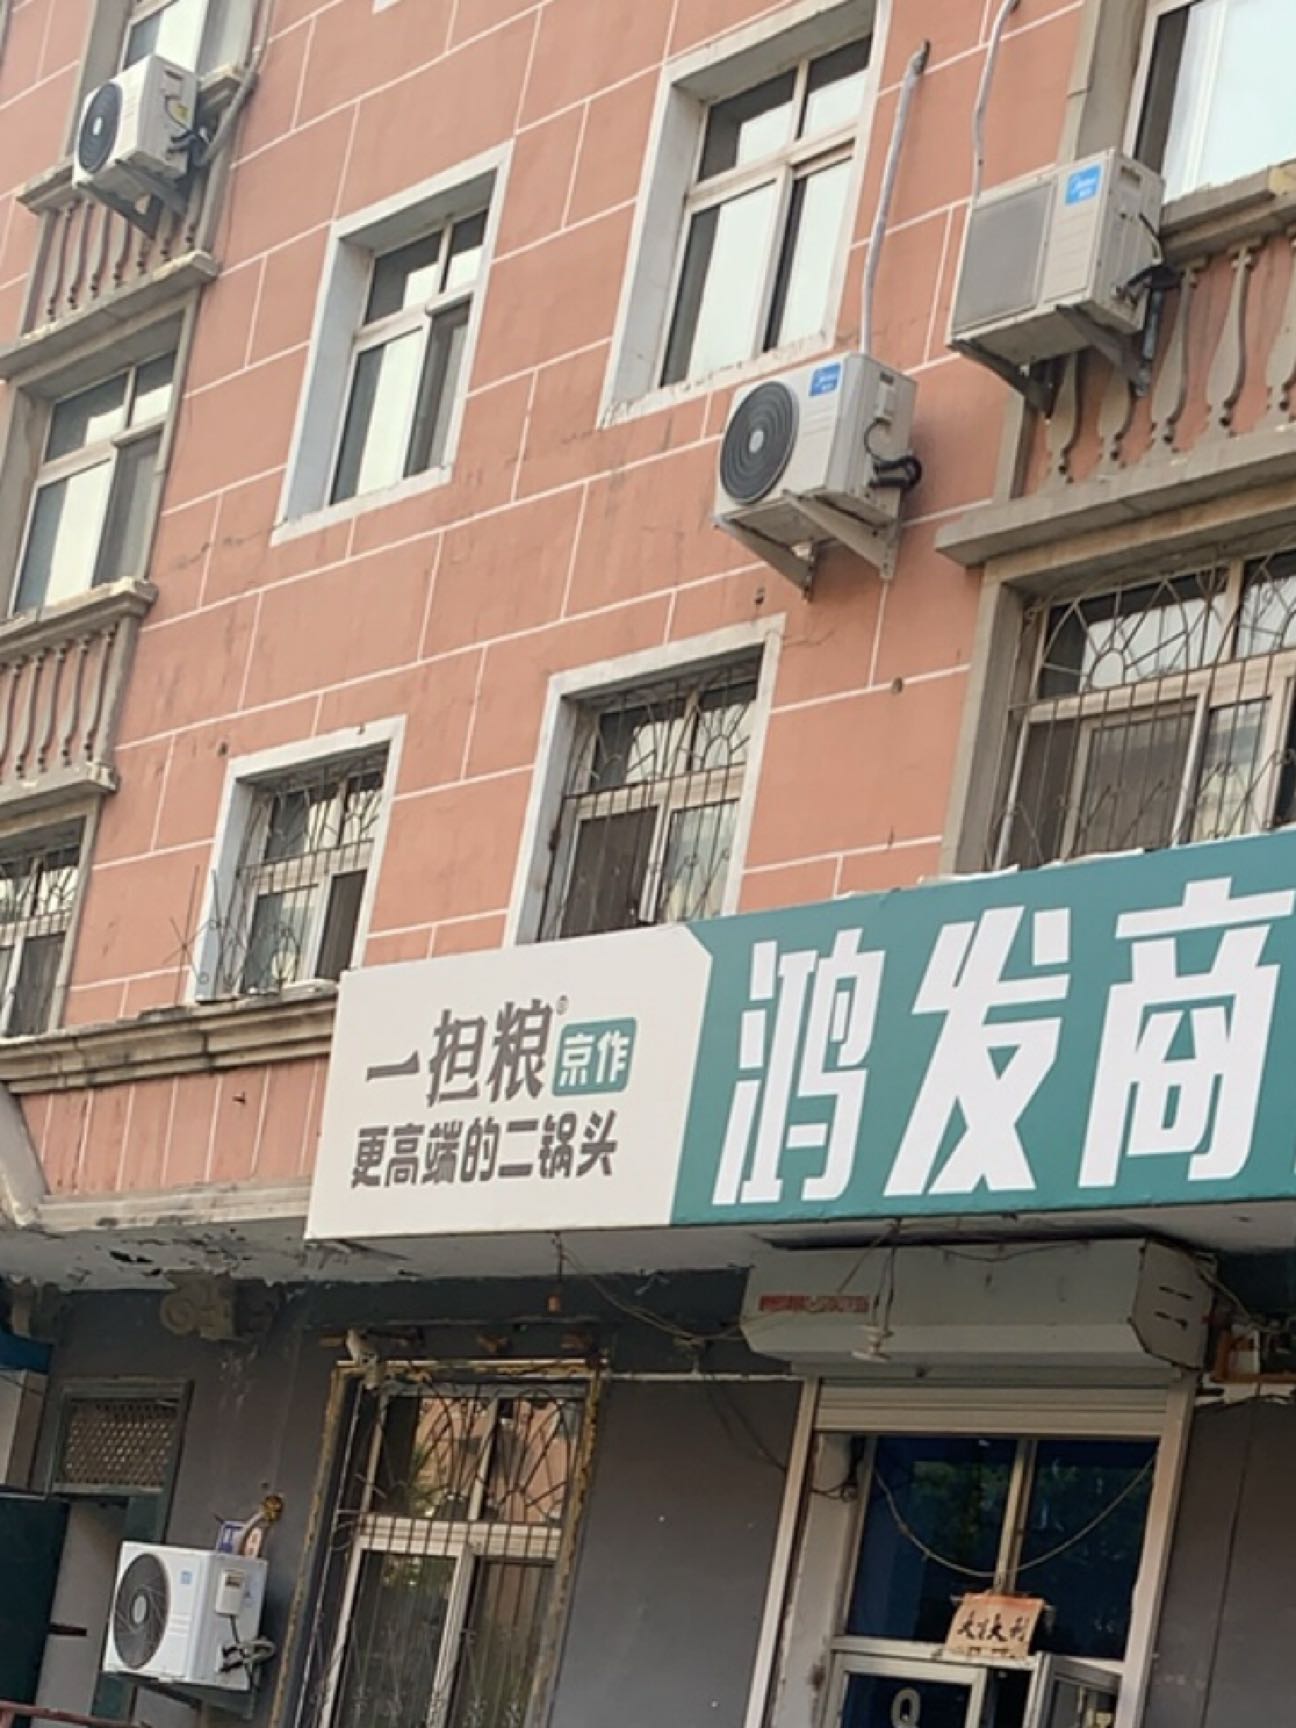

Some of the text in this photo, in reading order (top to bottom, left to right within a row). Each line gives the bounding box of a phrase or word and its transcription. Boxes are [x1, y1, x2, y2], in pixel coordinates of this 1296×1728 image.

[366, 999, 552, 1107] 一担粮
[557, 1027, 630, 1087] 京作
[351, 1110, 618, 1188] 更高端的二锅头
